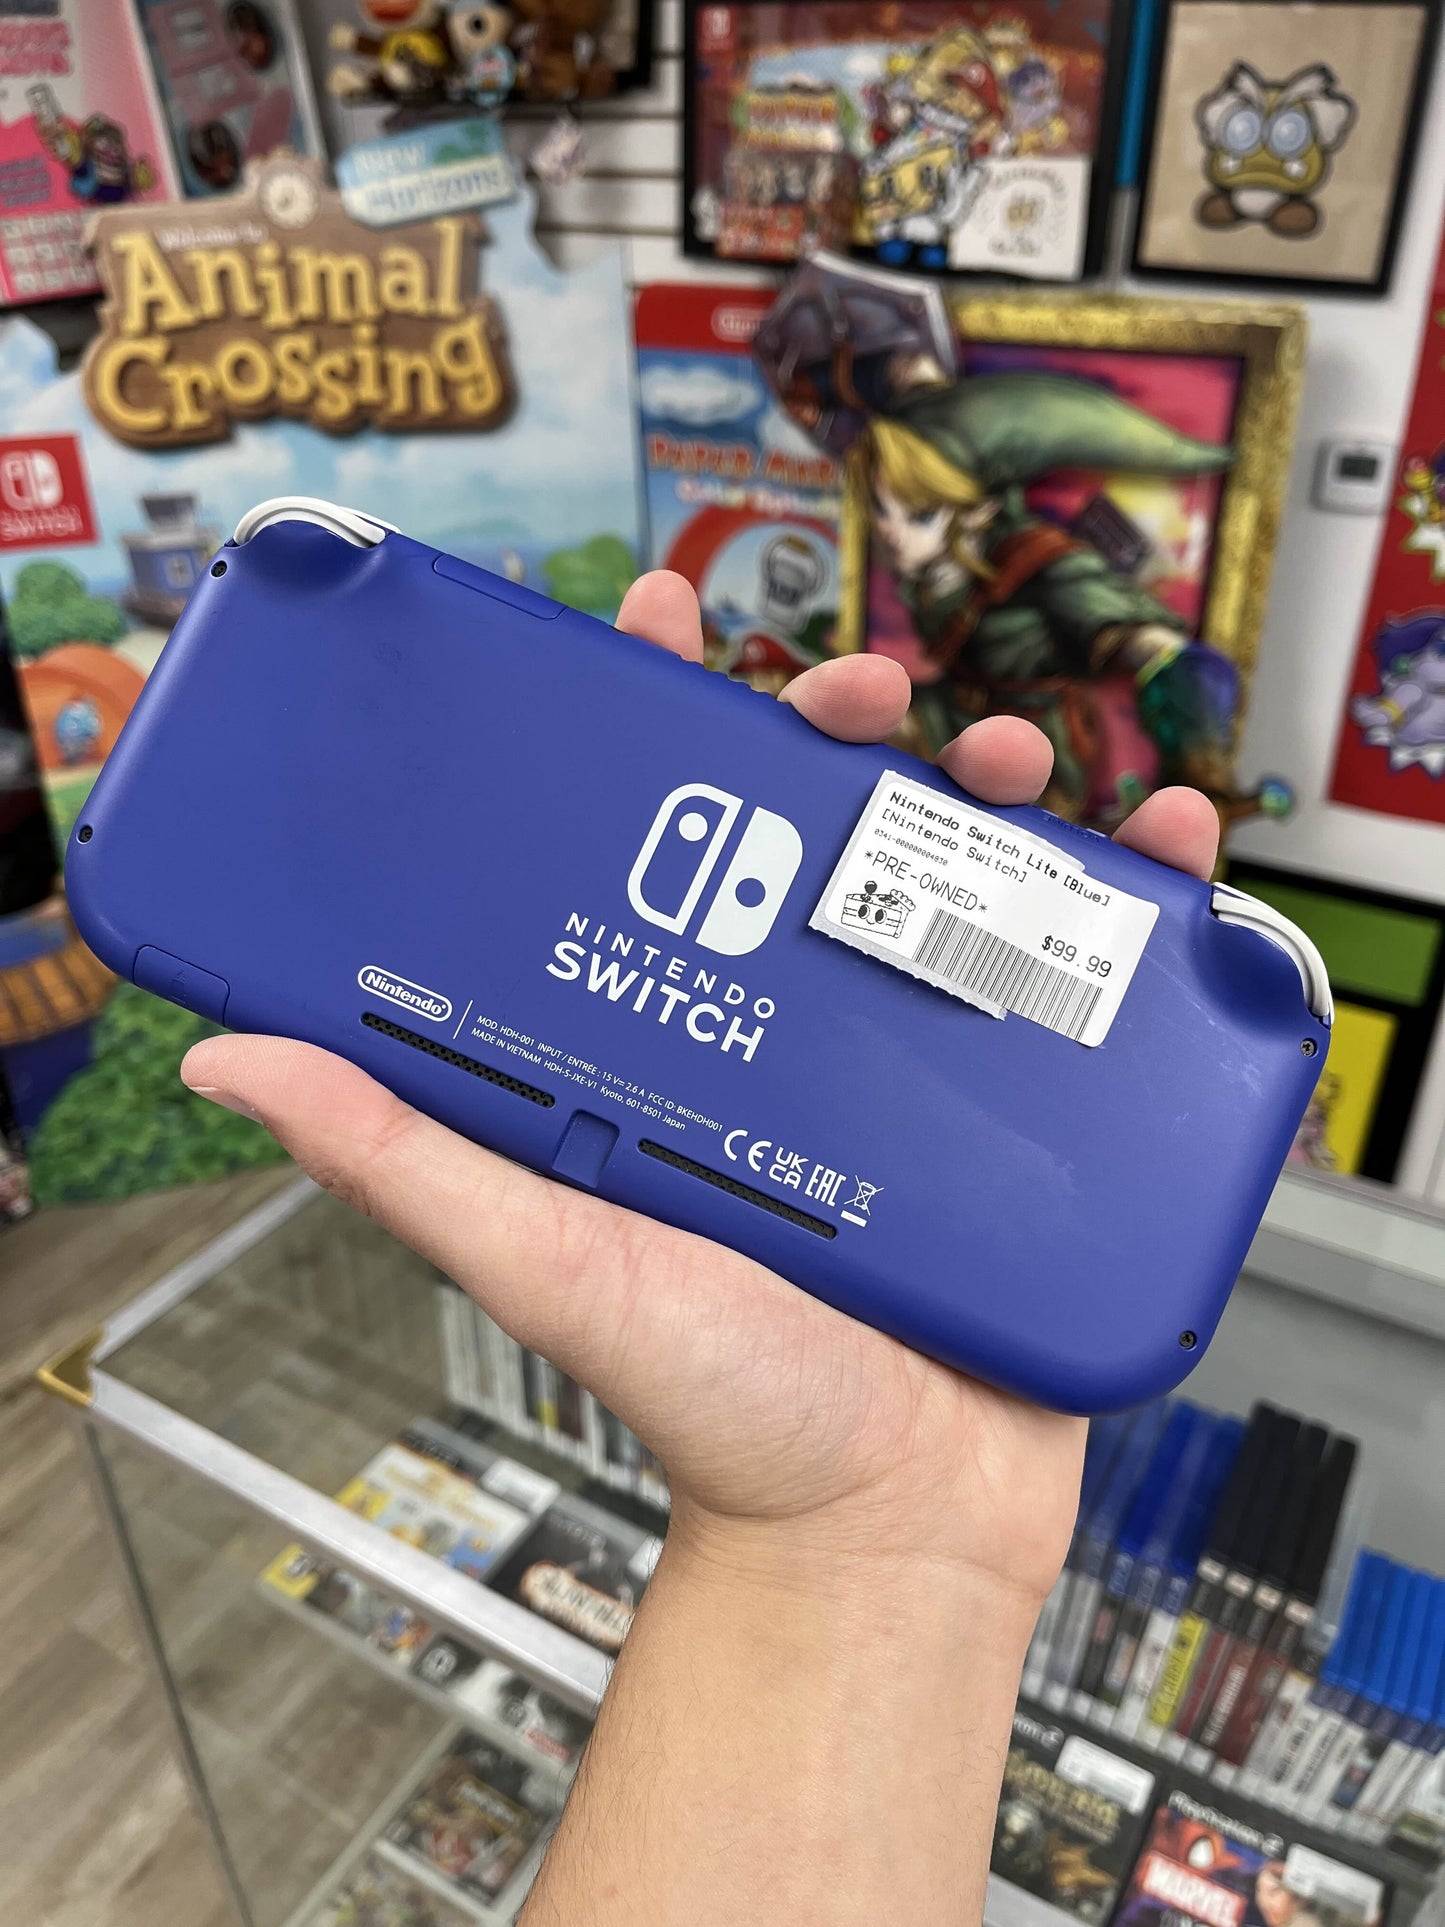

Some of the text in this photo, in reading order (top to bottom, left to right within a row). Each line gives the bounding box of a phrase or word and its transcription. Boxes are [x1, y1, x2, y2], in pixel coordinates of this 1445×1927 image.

[112, 220, 465, 334] Animal
[104, 316, 500, 431] Crossing
[881, 808, 1027, 883] [Nintendo Switch]
[889, 791, 1111, 907] Nintendo Switch Lite [Blue]
[365, 971, 448, 1016] Nintendo
[545, 940, 765, 1063] SWITCH
[565, 911, 776, 1020] NINTENDO
[1041, 935, 1113, 978] $99.99
[470, 1027, 686, 1131] MADE IN VIETNAM HDH-S-JXE-V1 Kyoto, 601-8501 Japan
[477, 1015, 499, 1031] MOD.
[499, 1025, 535, 1047] HDH-001
[537, 1042, 563, 1059] INPUT
[567, 1055, 597, 1075] ENTRÉE
[602, 1071, 613, 1082] 15
[625, 1082, 638, 1094] 2.6
[638, 1089, 645, 1097] A
[647, 1092, 665, 1106] FCC
[664, 1100, 676, 1111] ID:
[676, 1105, 723, 1132] BKEHDH001
